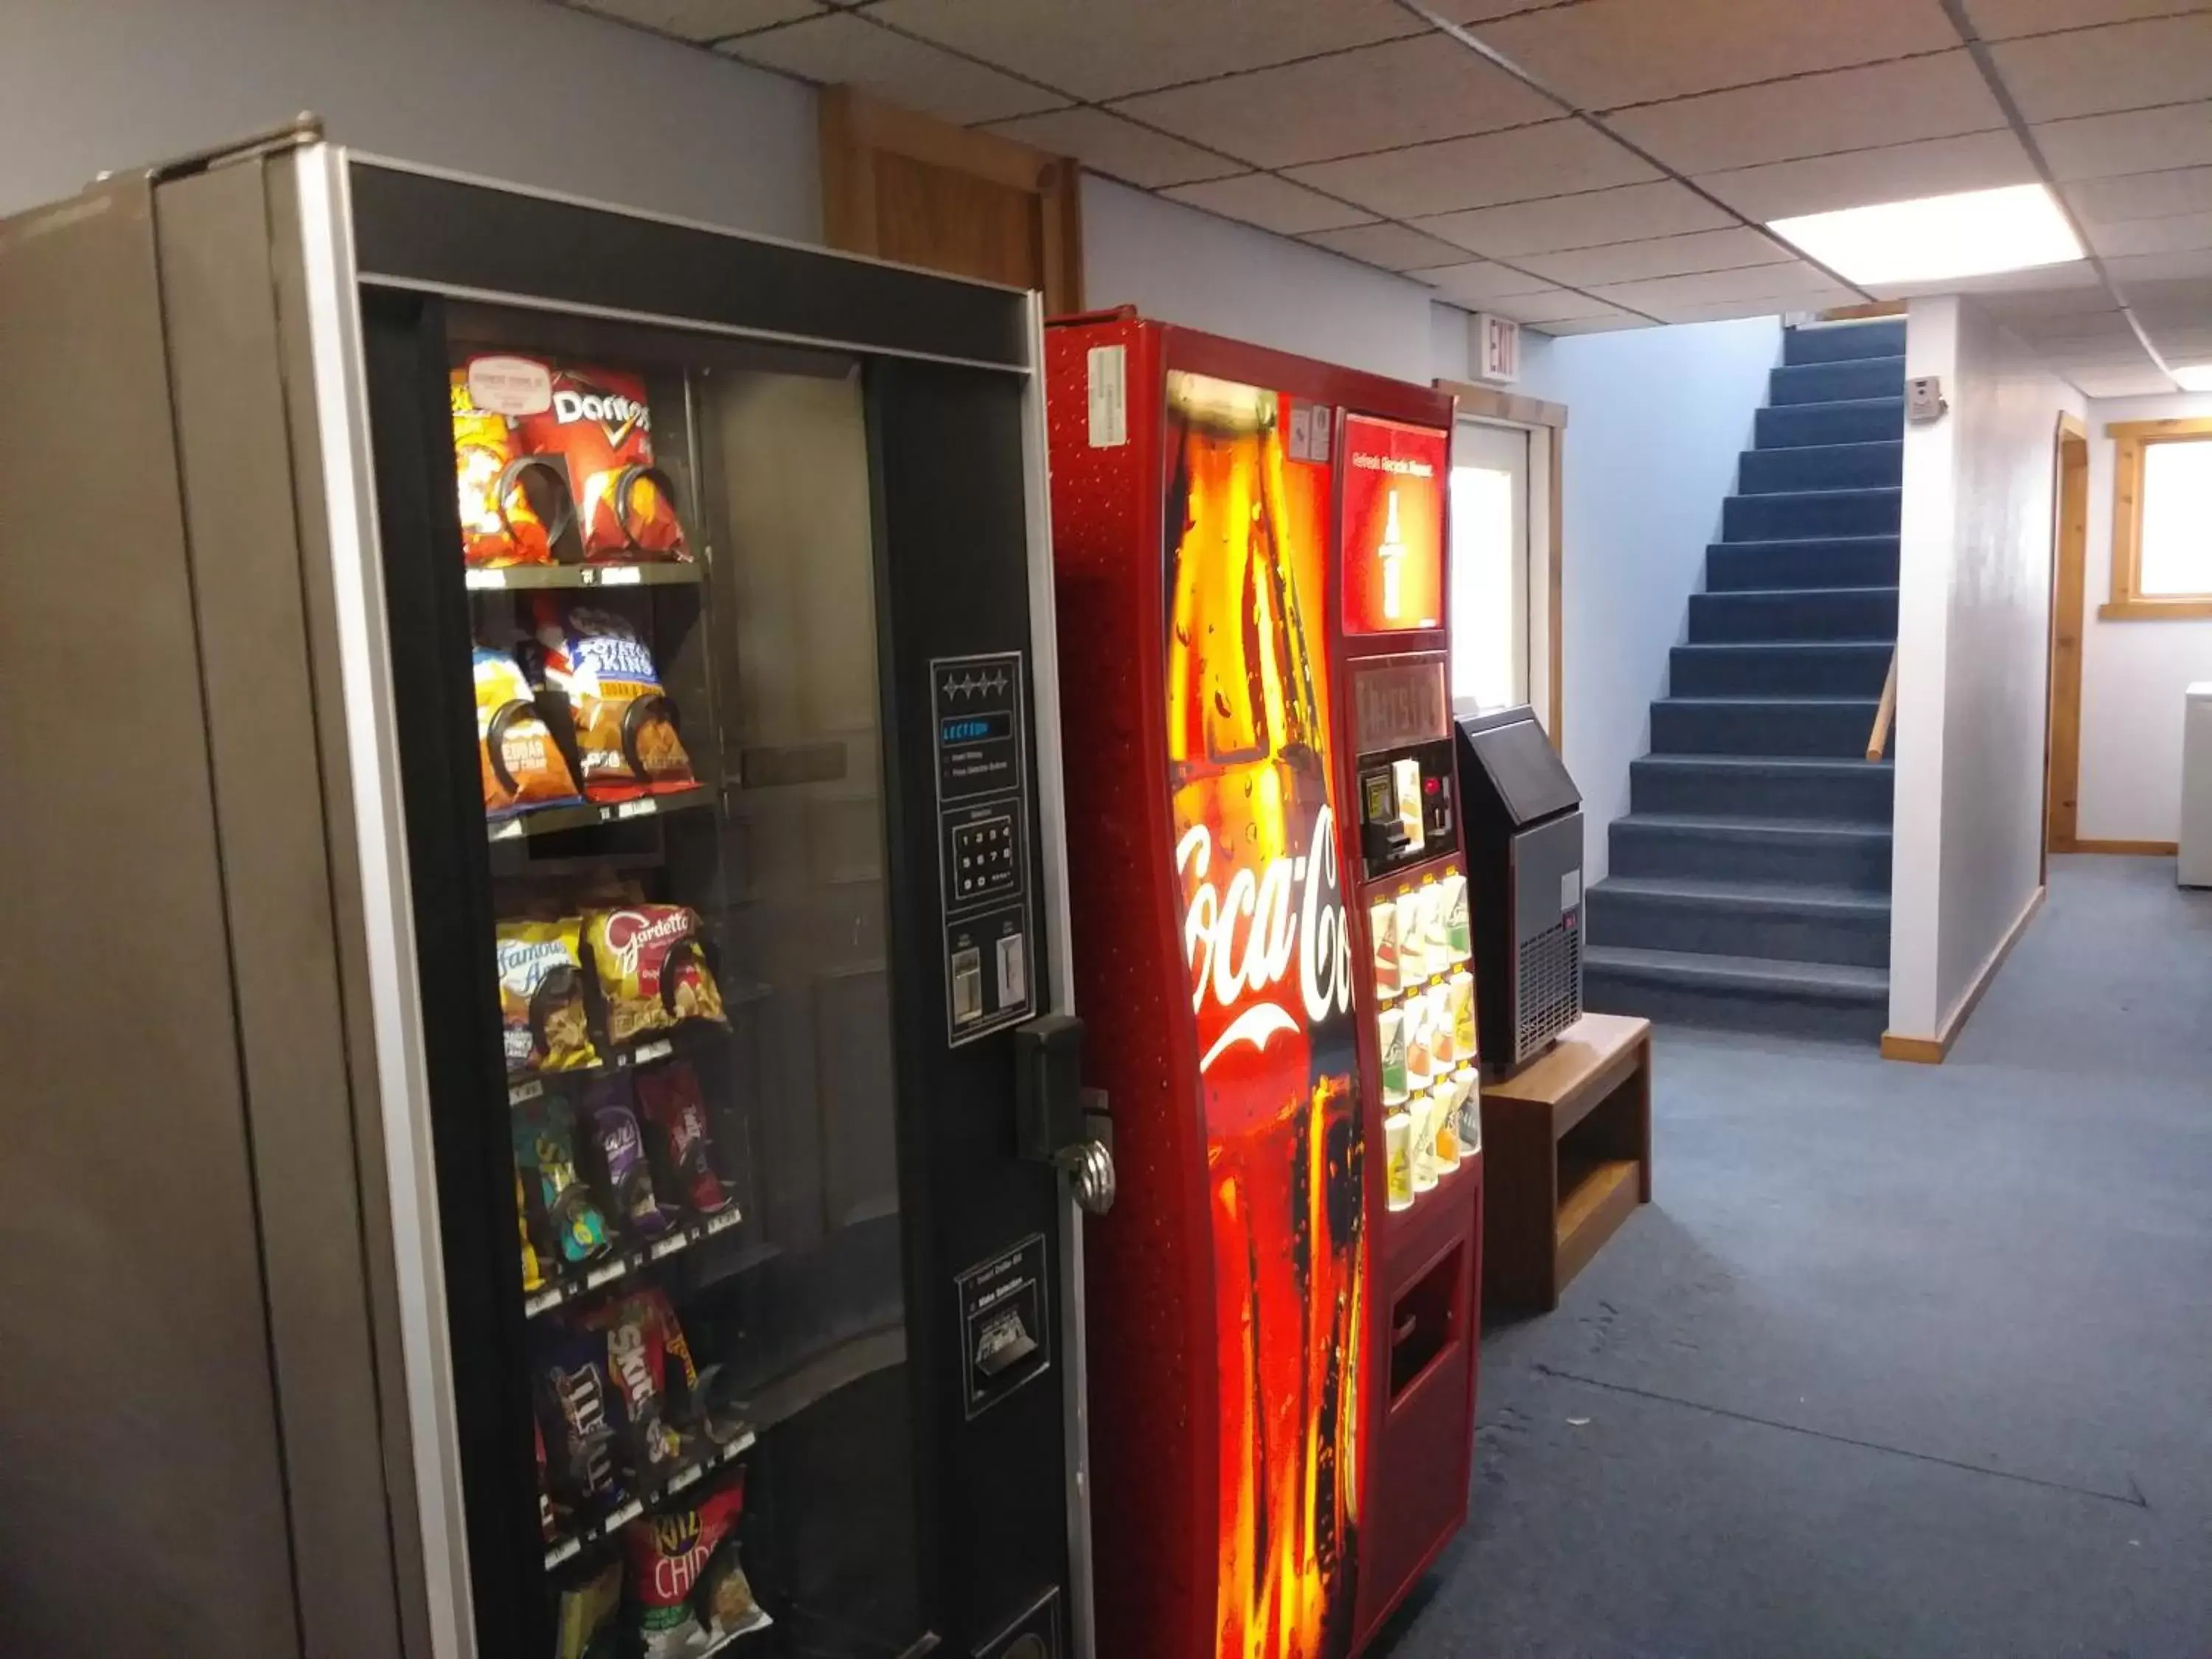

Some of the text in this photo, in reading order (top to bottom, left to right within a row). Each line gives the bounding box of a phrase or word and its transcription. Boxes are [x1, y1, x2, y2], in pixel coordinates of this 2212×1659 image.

[1489, 319, 1514, 375] EXIT
[553, 389, 652, 432] Doritos
[1176, 804, 1356, 1022] Coca-Co
